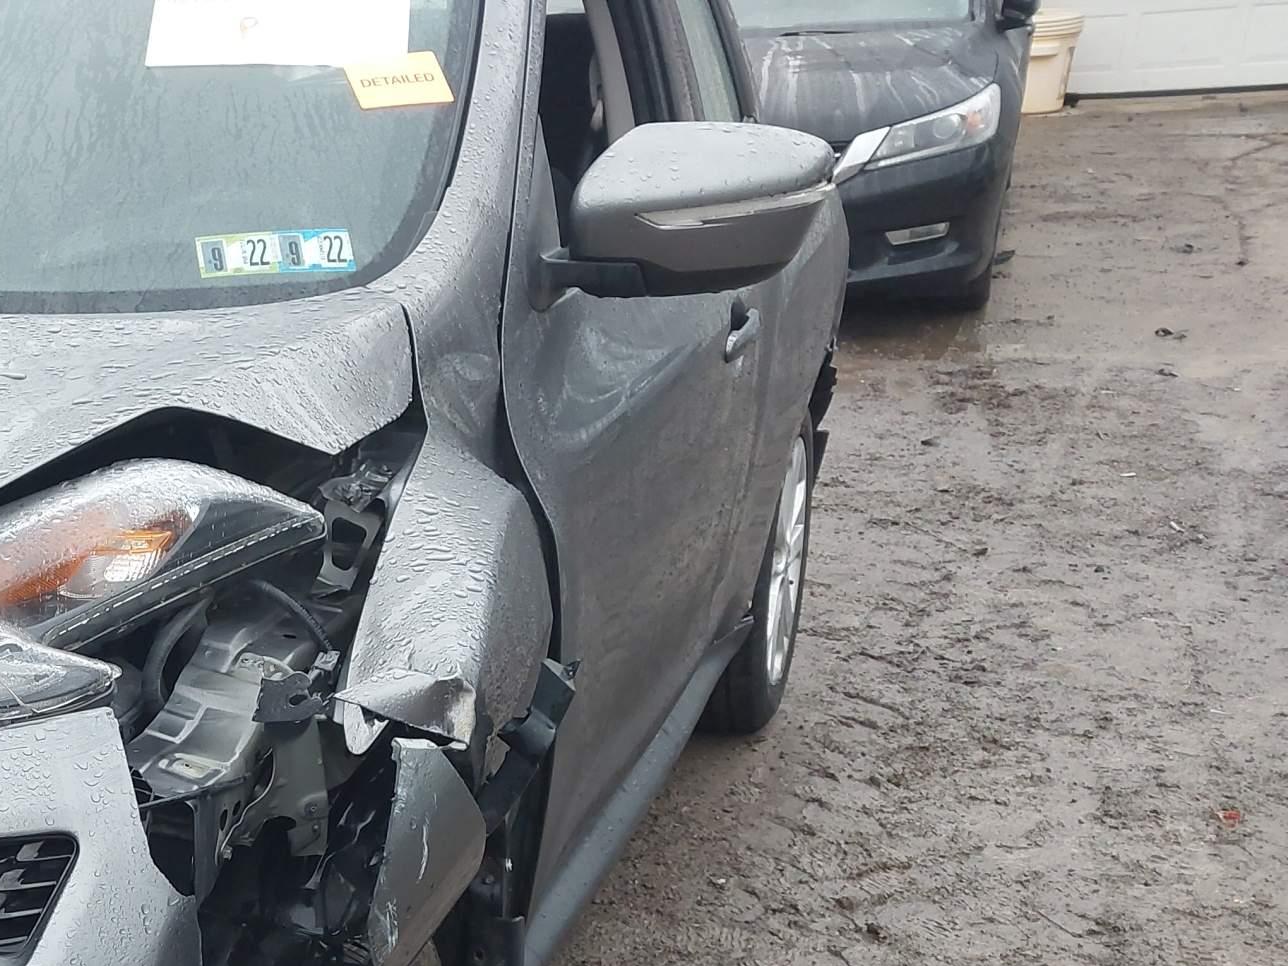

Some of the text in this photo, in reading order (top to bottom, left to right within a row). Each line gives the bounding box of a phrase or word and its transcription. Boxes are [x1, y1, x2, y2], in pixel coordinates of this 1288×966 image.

[359, 72, 435, 88] DETAILED
[211, 247, 224, 271] 9
[246, 238, 270, 266] 22
[288, 241, 301, 266] 9
[323, 235, 348, 263] 22
